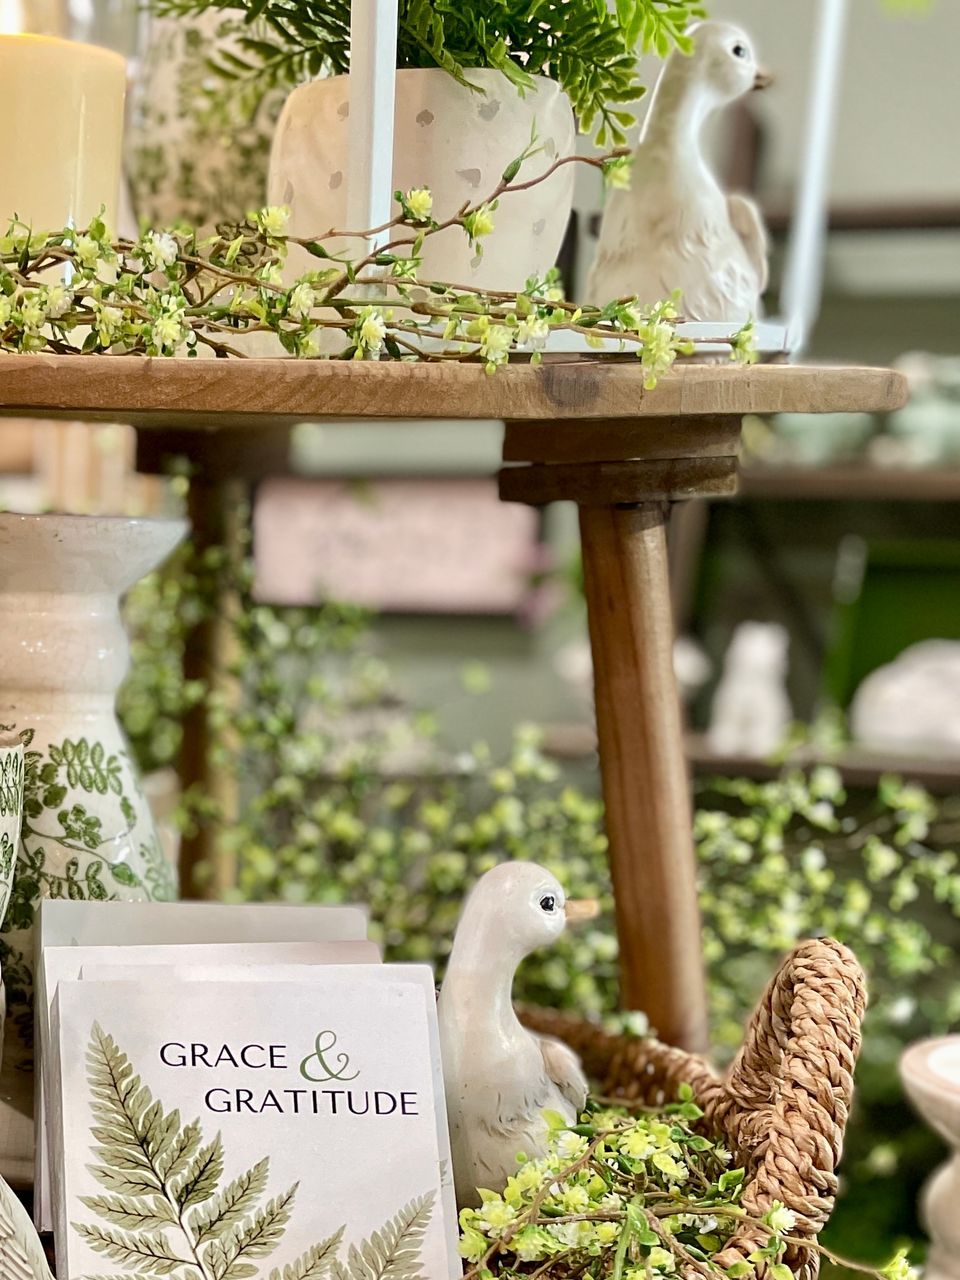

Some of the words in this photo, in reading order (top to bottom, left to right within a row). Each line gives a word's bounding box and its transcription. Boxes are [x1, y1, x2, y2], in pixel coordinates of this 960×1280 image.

[159, 1042, 288, 1069] GRACE
[299, 1030, 361, 1083] &
[204, 1088, 419, 1116] GRATITUDE
